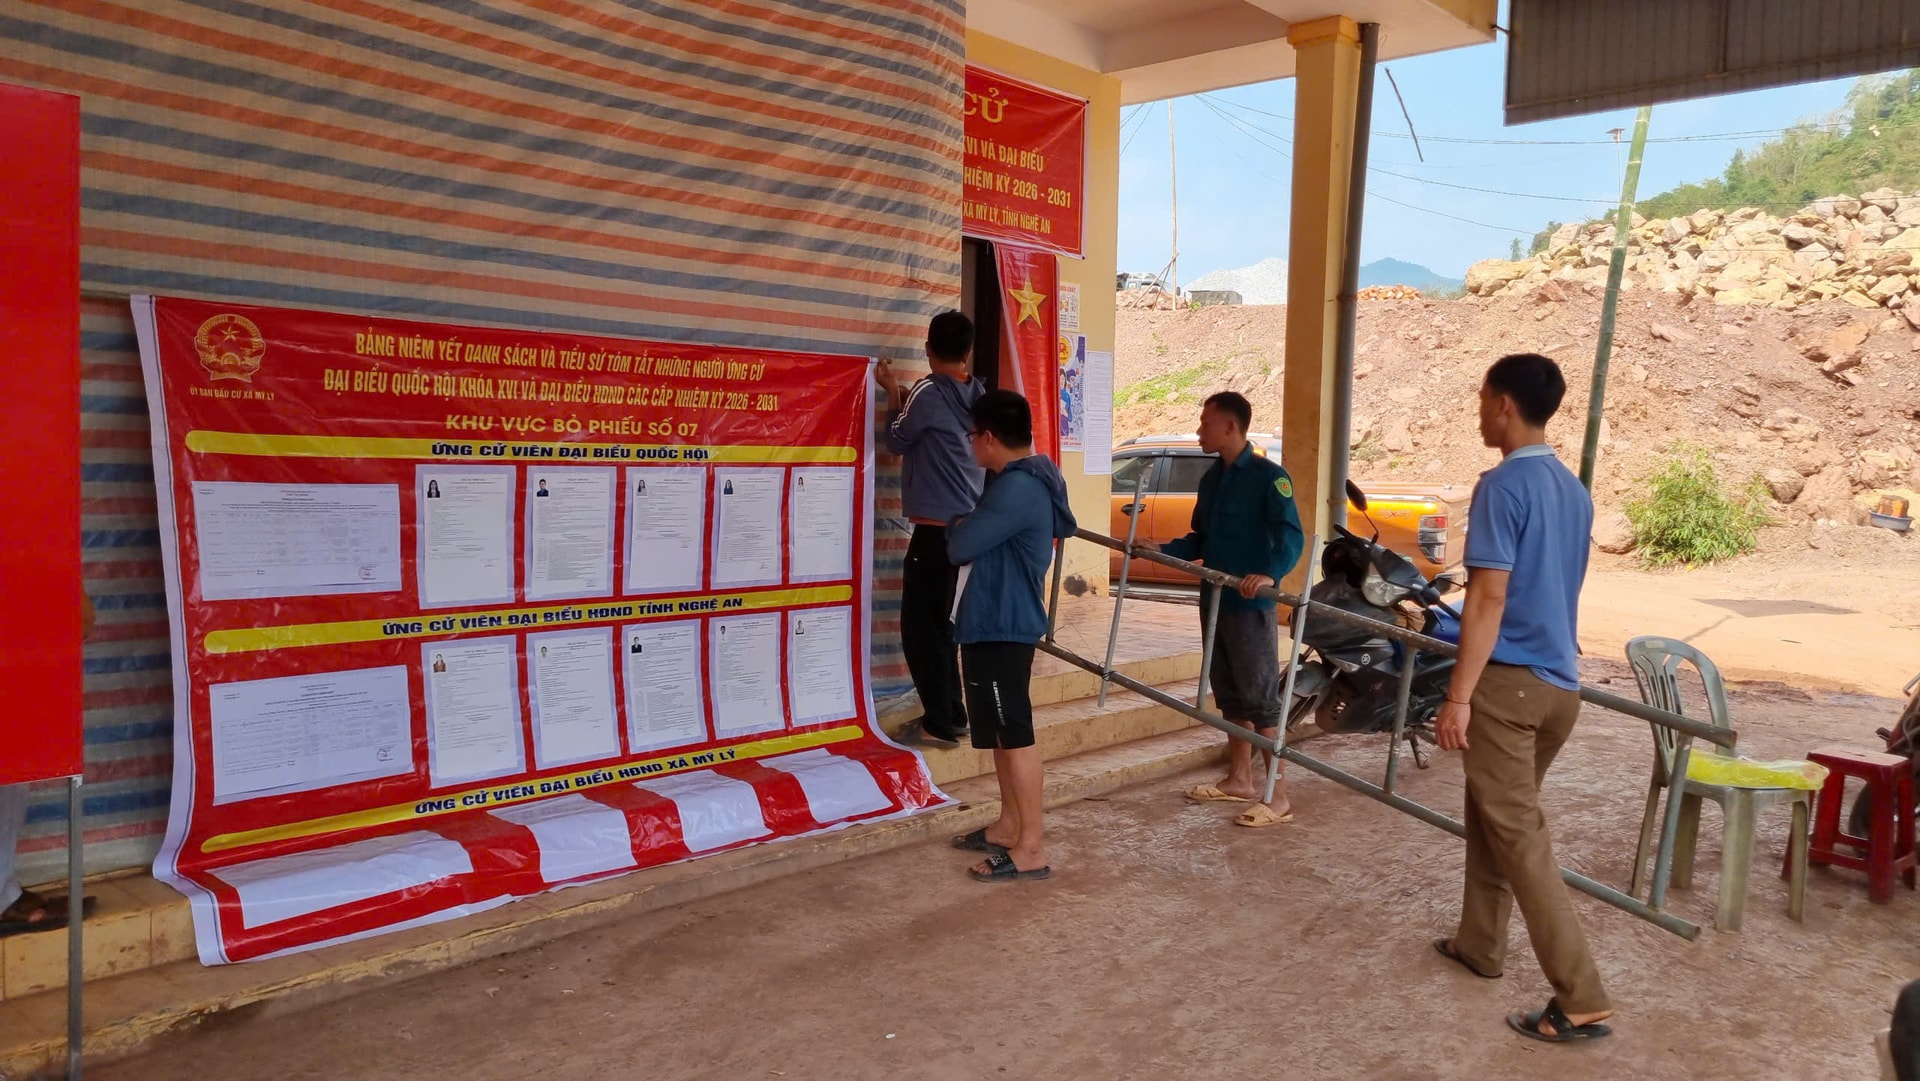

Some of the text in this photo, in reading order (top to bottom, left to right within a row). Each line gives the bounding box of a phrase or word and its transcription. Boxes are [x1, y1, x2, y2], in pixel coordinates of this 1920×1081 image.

[963, 87, 1009, 123] CỬ
[981, 138, 996, 160] VÀ
[999, 145, 1017, 168] ĐẠI
[1020, 147, 1044, 172] BIỂU
[963, 166, 993, 191] HIỆM
[996, 173, 1010, 193] KỲ
[1013, 178, 1038, 200] 2026
[1047, 187, 1071, 208] 2031
[963, 199, 974, 218] XÃ
[976, 202, 988, 221] MỸ
[1002, 205, 1019, 227] TỈNH
[1020, 214, 1039, 235] NGHỆ
[1040, 218, 1051, 234] AN
[356, 326, 765, 381] BẢNG NIÊM YẾT DANH SÁCH VÀ TIỂU SỬ TÓM TẮT NHỮNG NGƯỜI ỨNG CỬ
[324, 368, 350, 396] ĐẠI
[354, 363, 388, 394] BIỂU
[391, 367, 430, 396] QUỐC
[433, 371, 456, 401] HỘI
[460, 374, 494, 399] KHÓA
[498, 379, 517, 399] XVI
[521, 377, 537, 401] VÀ
[540, 382, 560, 406] ĐẠI
[563, 376, 592, 403] BIỂU
[593, 385, 625, 405] HĐND
[626, 384, 649, 406] CÁC
[651, 382, 674, 407] CẤP
[674, 387, 710, 412] NHIỆM
[709, 388, 726, 409] KỲ
[725, 392, 749, 410] 2026
[756, 394, 779, 411] 2031
[446, 414, 698, 436] KHU VỰC BỎ PHIẾU SỐ 07
[432, 442, 709, 461] ỨNG CỬ VIÊN ĐẠI BIỂU QUỐC HỘI
[382, 598, 743, 635] ỨNG CỬ VIÊN ĐẠI BIỂU HĐND TỈNH NGHỆ AN
[415, 748, 736, 814] ỨNG CỬ VIÊN ĐẠI BIỂU HĐND XÃ MỸ LÝ
